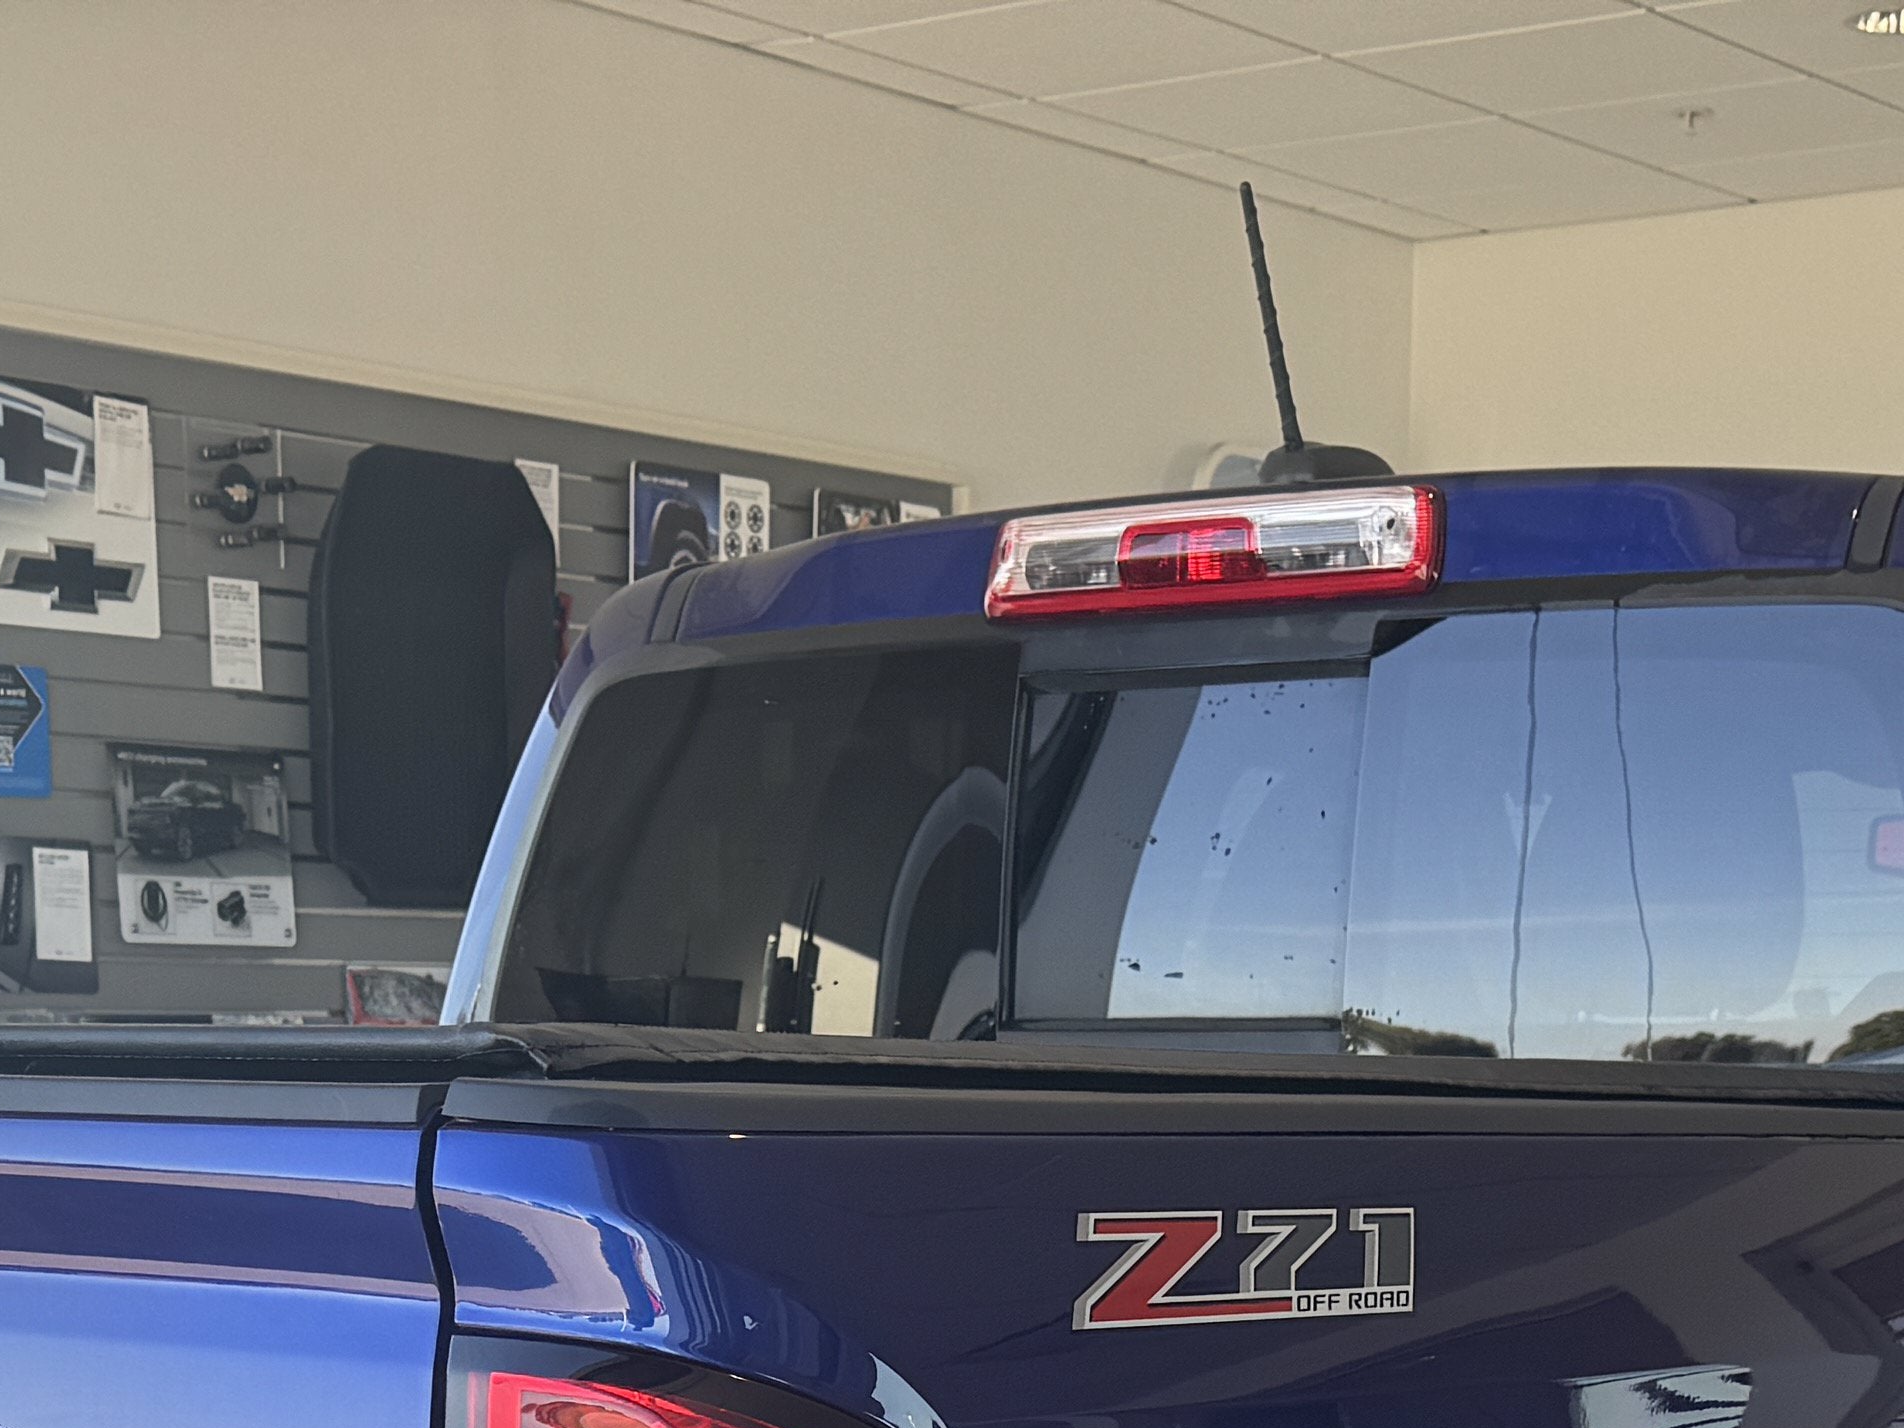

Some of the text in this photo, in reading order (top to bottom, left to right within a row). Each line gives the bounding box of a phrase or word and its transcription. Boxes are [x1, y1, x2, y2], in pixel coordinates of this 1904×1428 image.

[1072, 1207, 1415, 1331] Z71
[1296, 1290, 1410, 1312] OFF ROAD
